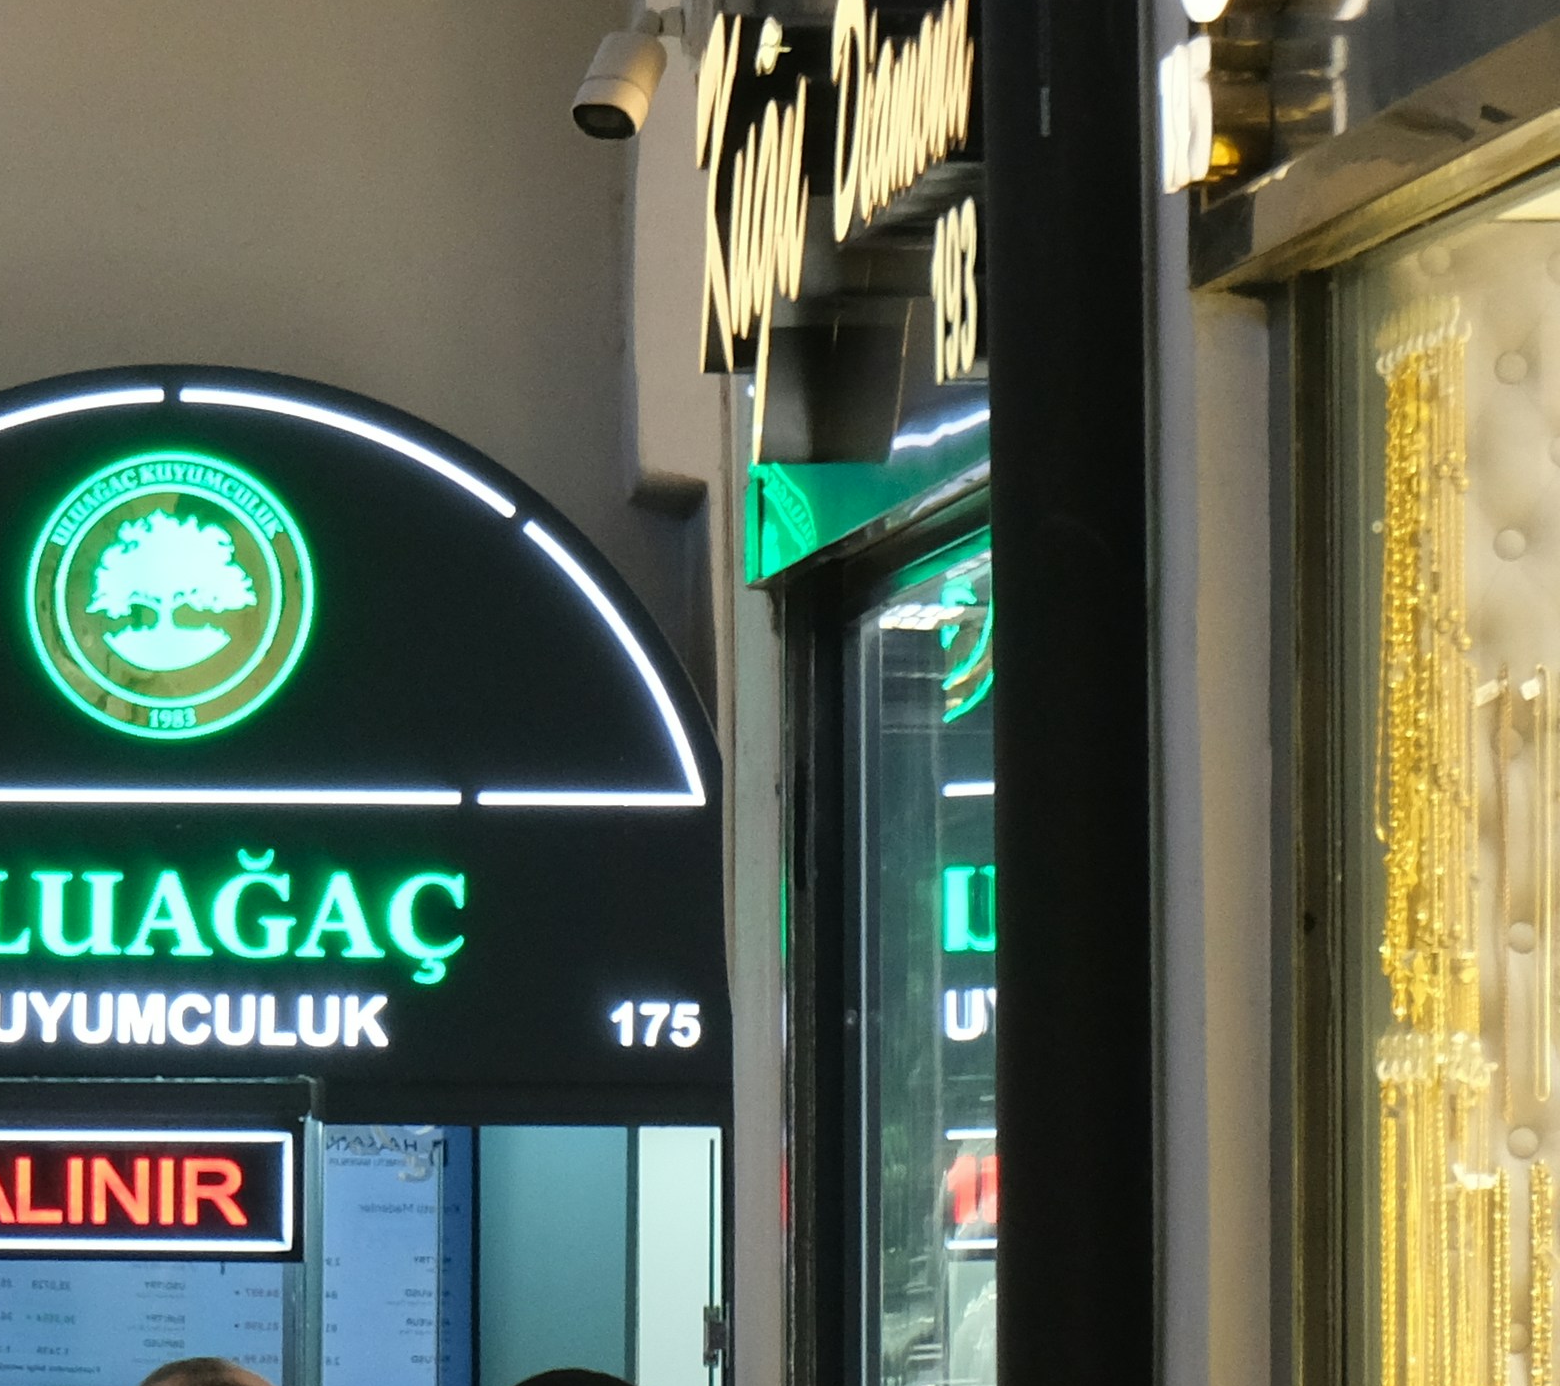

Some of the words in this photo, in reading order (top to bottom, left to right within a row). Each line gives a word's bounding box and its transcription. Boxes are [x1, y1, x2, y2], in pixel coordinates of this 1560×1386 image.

[930, 196, 978, 385] 193
[148, 706, 197, 729] 1983
[610, 1001, 702, 1049] 175
